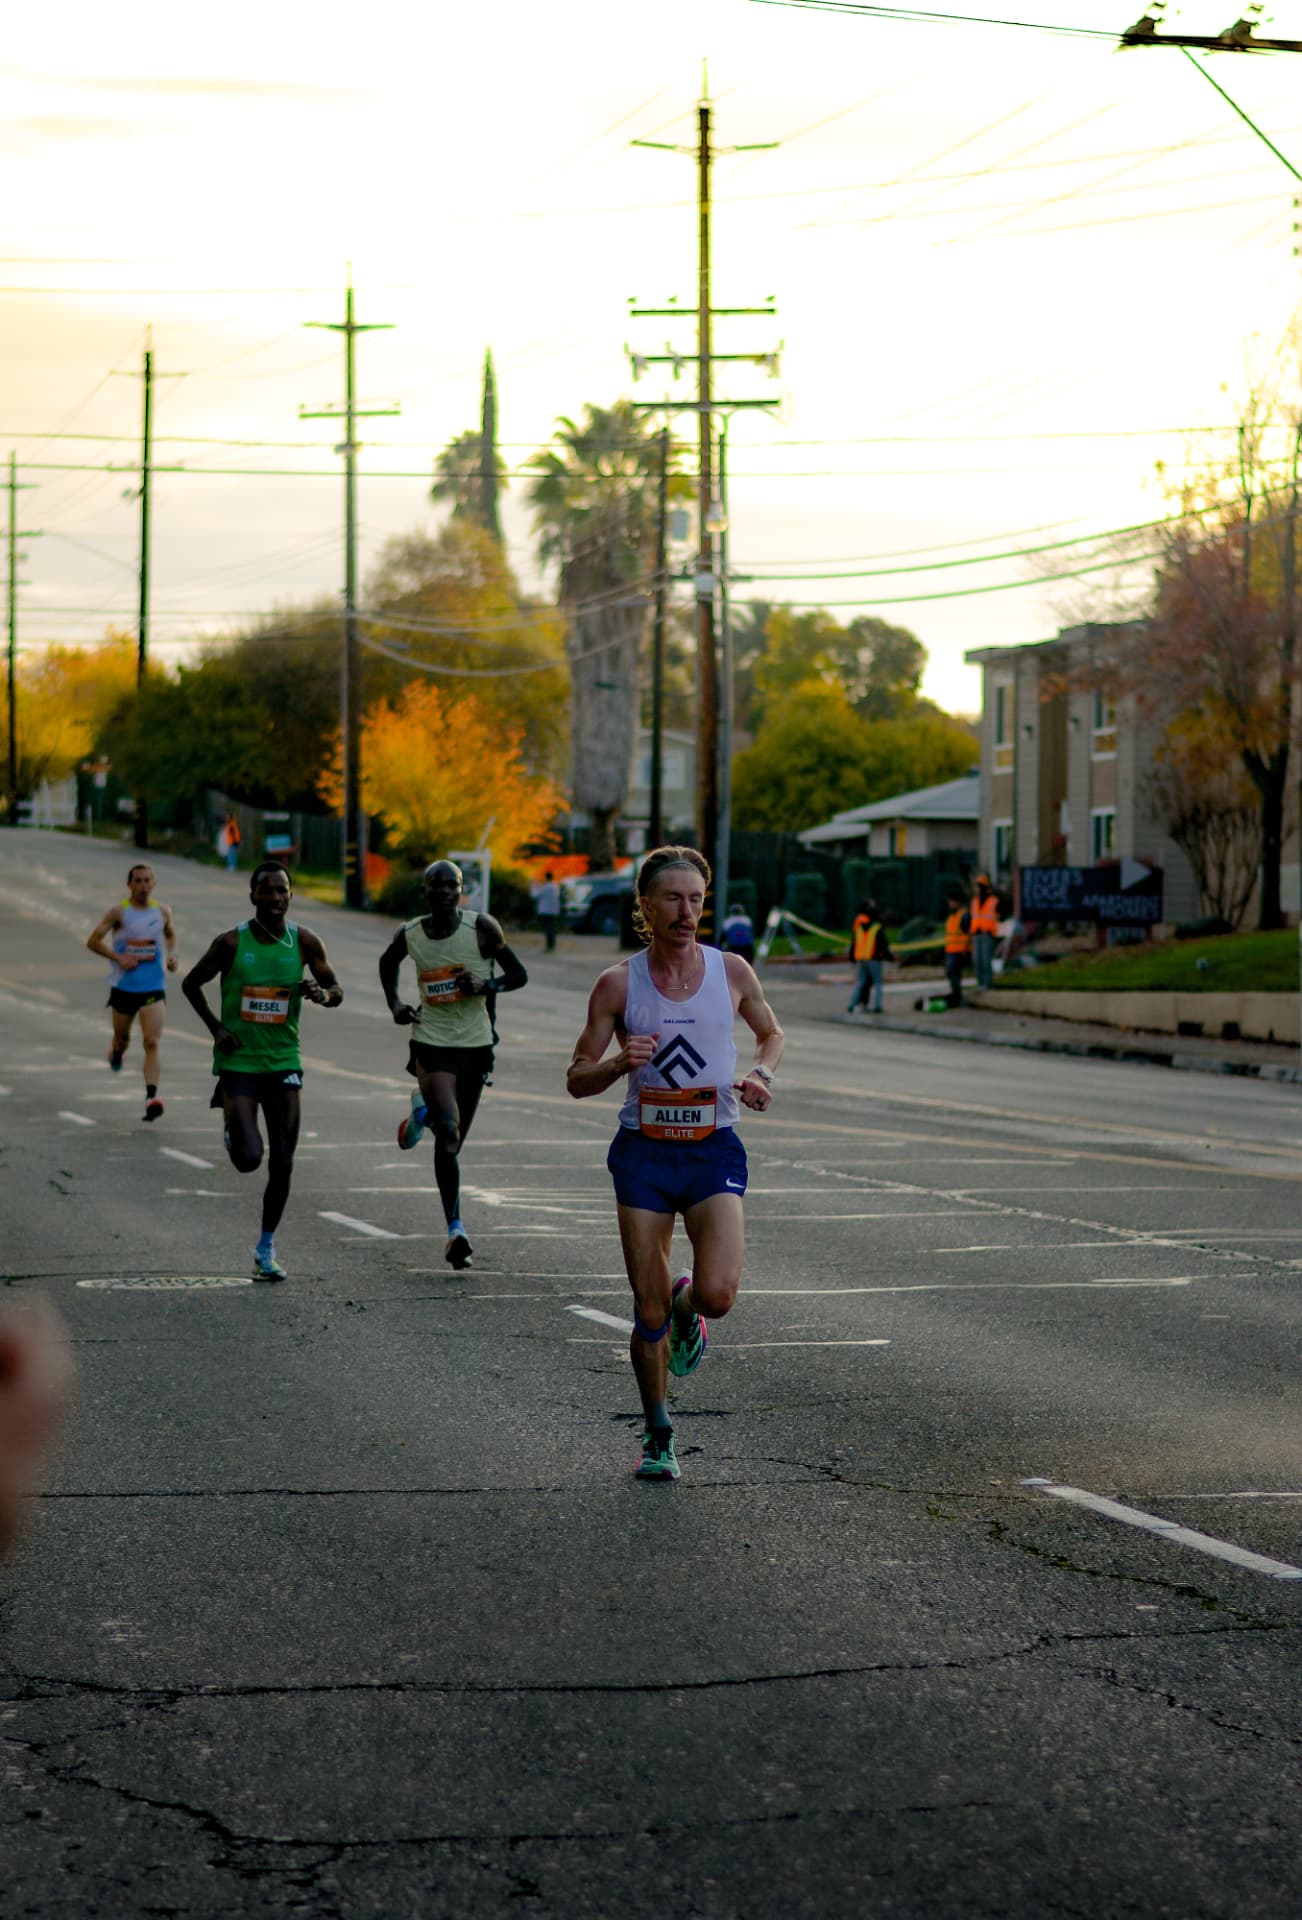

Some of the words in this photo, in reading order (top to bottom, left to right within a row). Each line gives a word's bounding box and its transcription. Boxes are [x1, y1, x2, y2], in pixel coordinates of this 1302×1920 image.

[1023, 885, 1070, 900] EDGE
[1081, 895, 1160, 907] APARTMENT
[1099, 906, 1160, 920] HOMES
[250, 1001, 280, 1012] MESEL
[655, 1110, 701, 1122] ALLEN
[664, 1128, 695, 1138] ELITE
